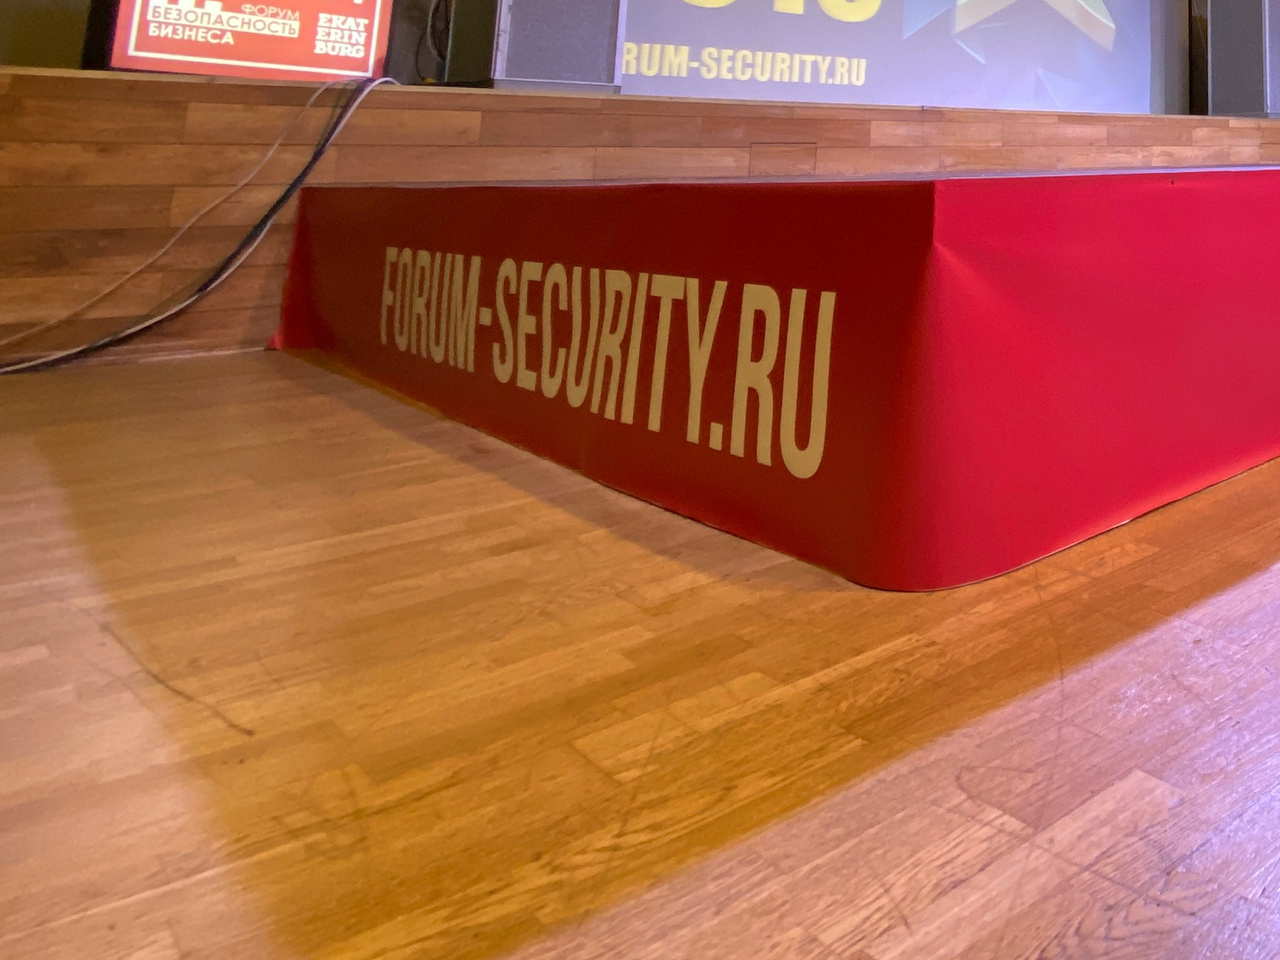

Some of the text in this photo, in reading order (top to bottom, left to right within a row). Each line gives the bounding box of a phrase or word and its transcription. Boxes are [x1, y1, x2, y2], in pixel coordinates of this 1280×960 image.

[151, 5, 298, 36] БЕЗОПАСНОСТЬ
[240, 3, 300, 21] ФОРУМ
[317, 13, 369, 31] EKAT
[149, 22, 235, 45] БИЗНЕСА
[315, 27, 368, 45] ERIN
[313, 40, 365, 58] BURG
[380, 246, 837, 479] FORUM-SECURITY.RU
